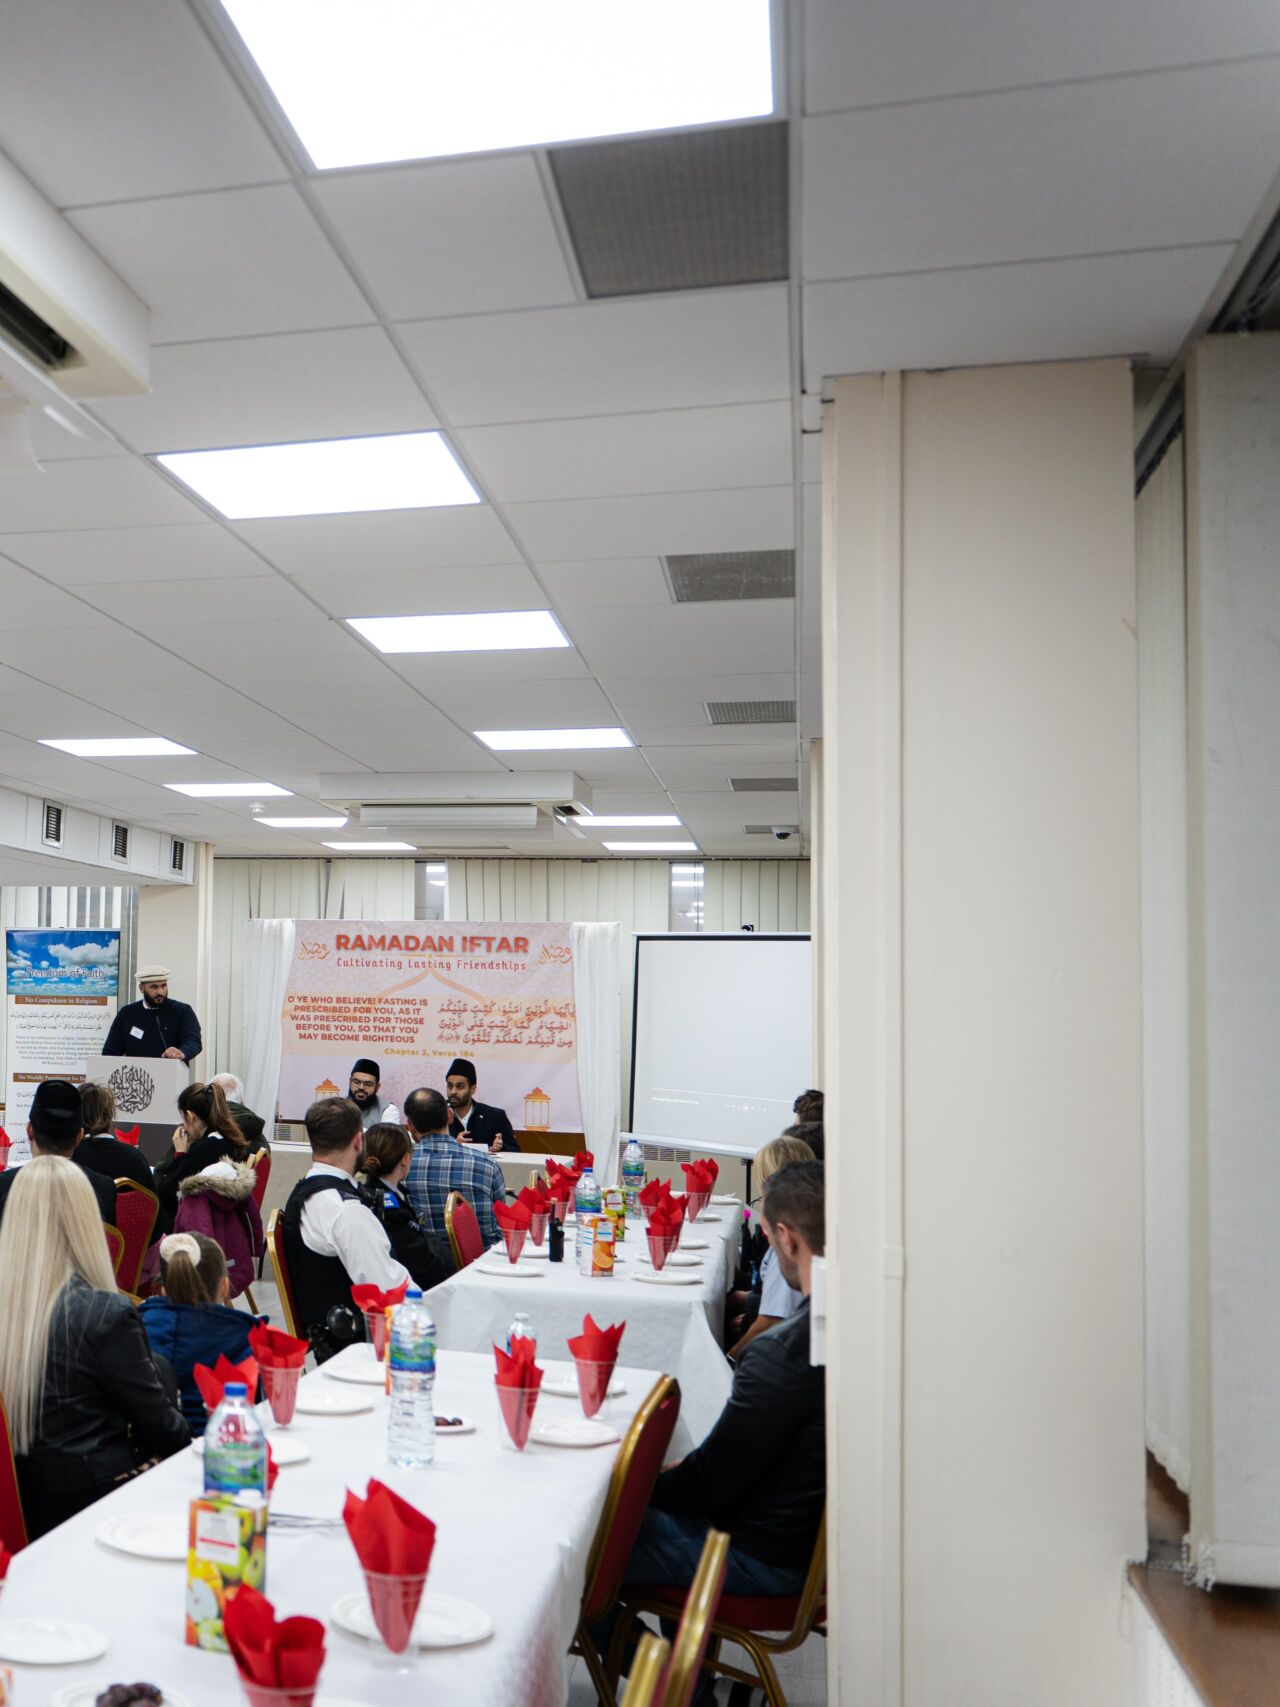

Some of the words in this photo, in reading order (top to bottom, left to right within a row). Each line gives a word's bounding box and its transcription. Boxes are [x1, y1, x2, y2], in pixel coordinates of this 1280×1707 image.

[335, 934, 454, 952] RAMADAN
[462, 936, 529, 953] IFTAR
[337, 957, 402, 970] Cultivating
[457, 960, 527, 972] Friendships
[25, 967, 67, 978] Freedom
[70, 968, 80, 978] of
[82, 968, 105, 979] Faith
[310, 996, 333, 1004] WHO
[335, 997, 376, 1005] BELIEVE!
[378, 998, 417, 1006] FASTING
[419, 998, 428, 1006] IS
[294, 1005, 351, 1014] PRESCRIBED
[353, 1006, 372, 1014] FOR
[374, 1007, 396, 1016] YOU,
[398, 1007, 410, 1015] AS
[290, 1014, 311, 1022] WAS
[314, 1015, 370, 1023] PRESCRIBED
[373, 1016, 392, 1024] FOR
[395, 1017, 425, 1025] THOSE
[296, 1023, 331, 1032] BEFORE
[334, 1024, 356, 1033] YOU,
[358, 1025, 370, 1033] SO
[373, 1025, 397, 1034] THAT
[399, 1026, 419, 1034] YOU
[298, 1033, 319, 1041] MAY
[321, 1033, 360, 1042] BECOME
[362, 1035, 416, 1043] RIGHTEOUS
[384, 1047, 419, 1056] Chapter
